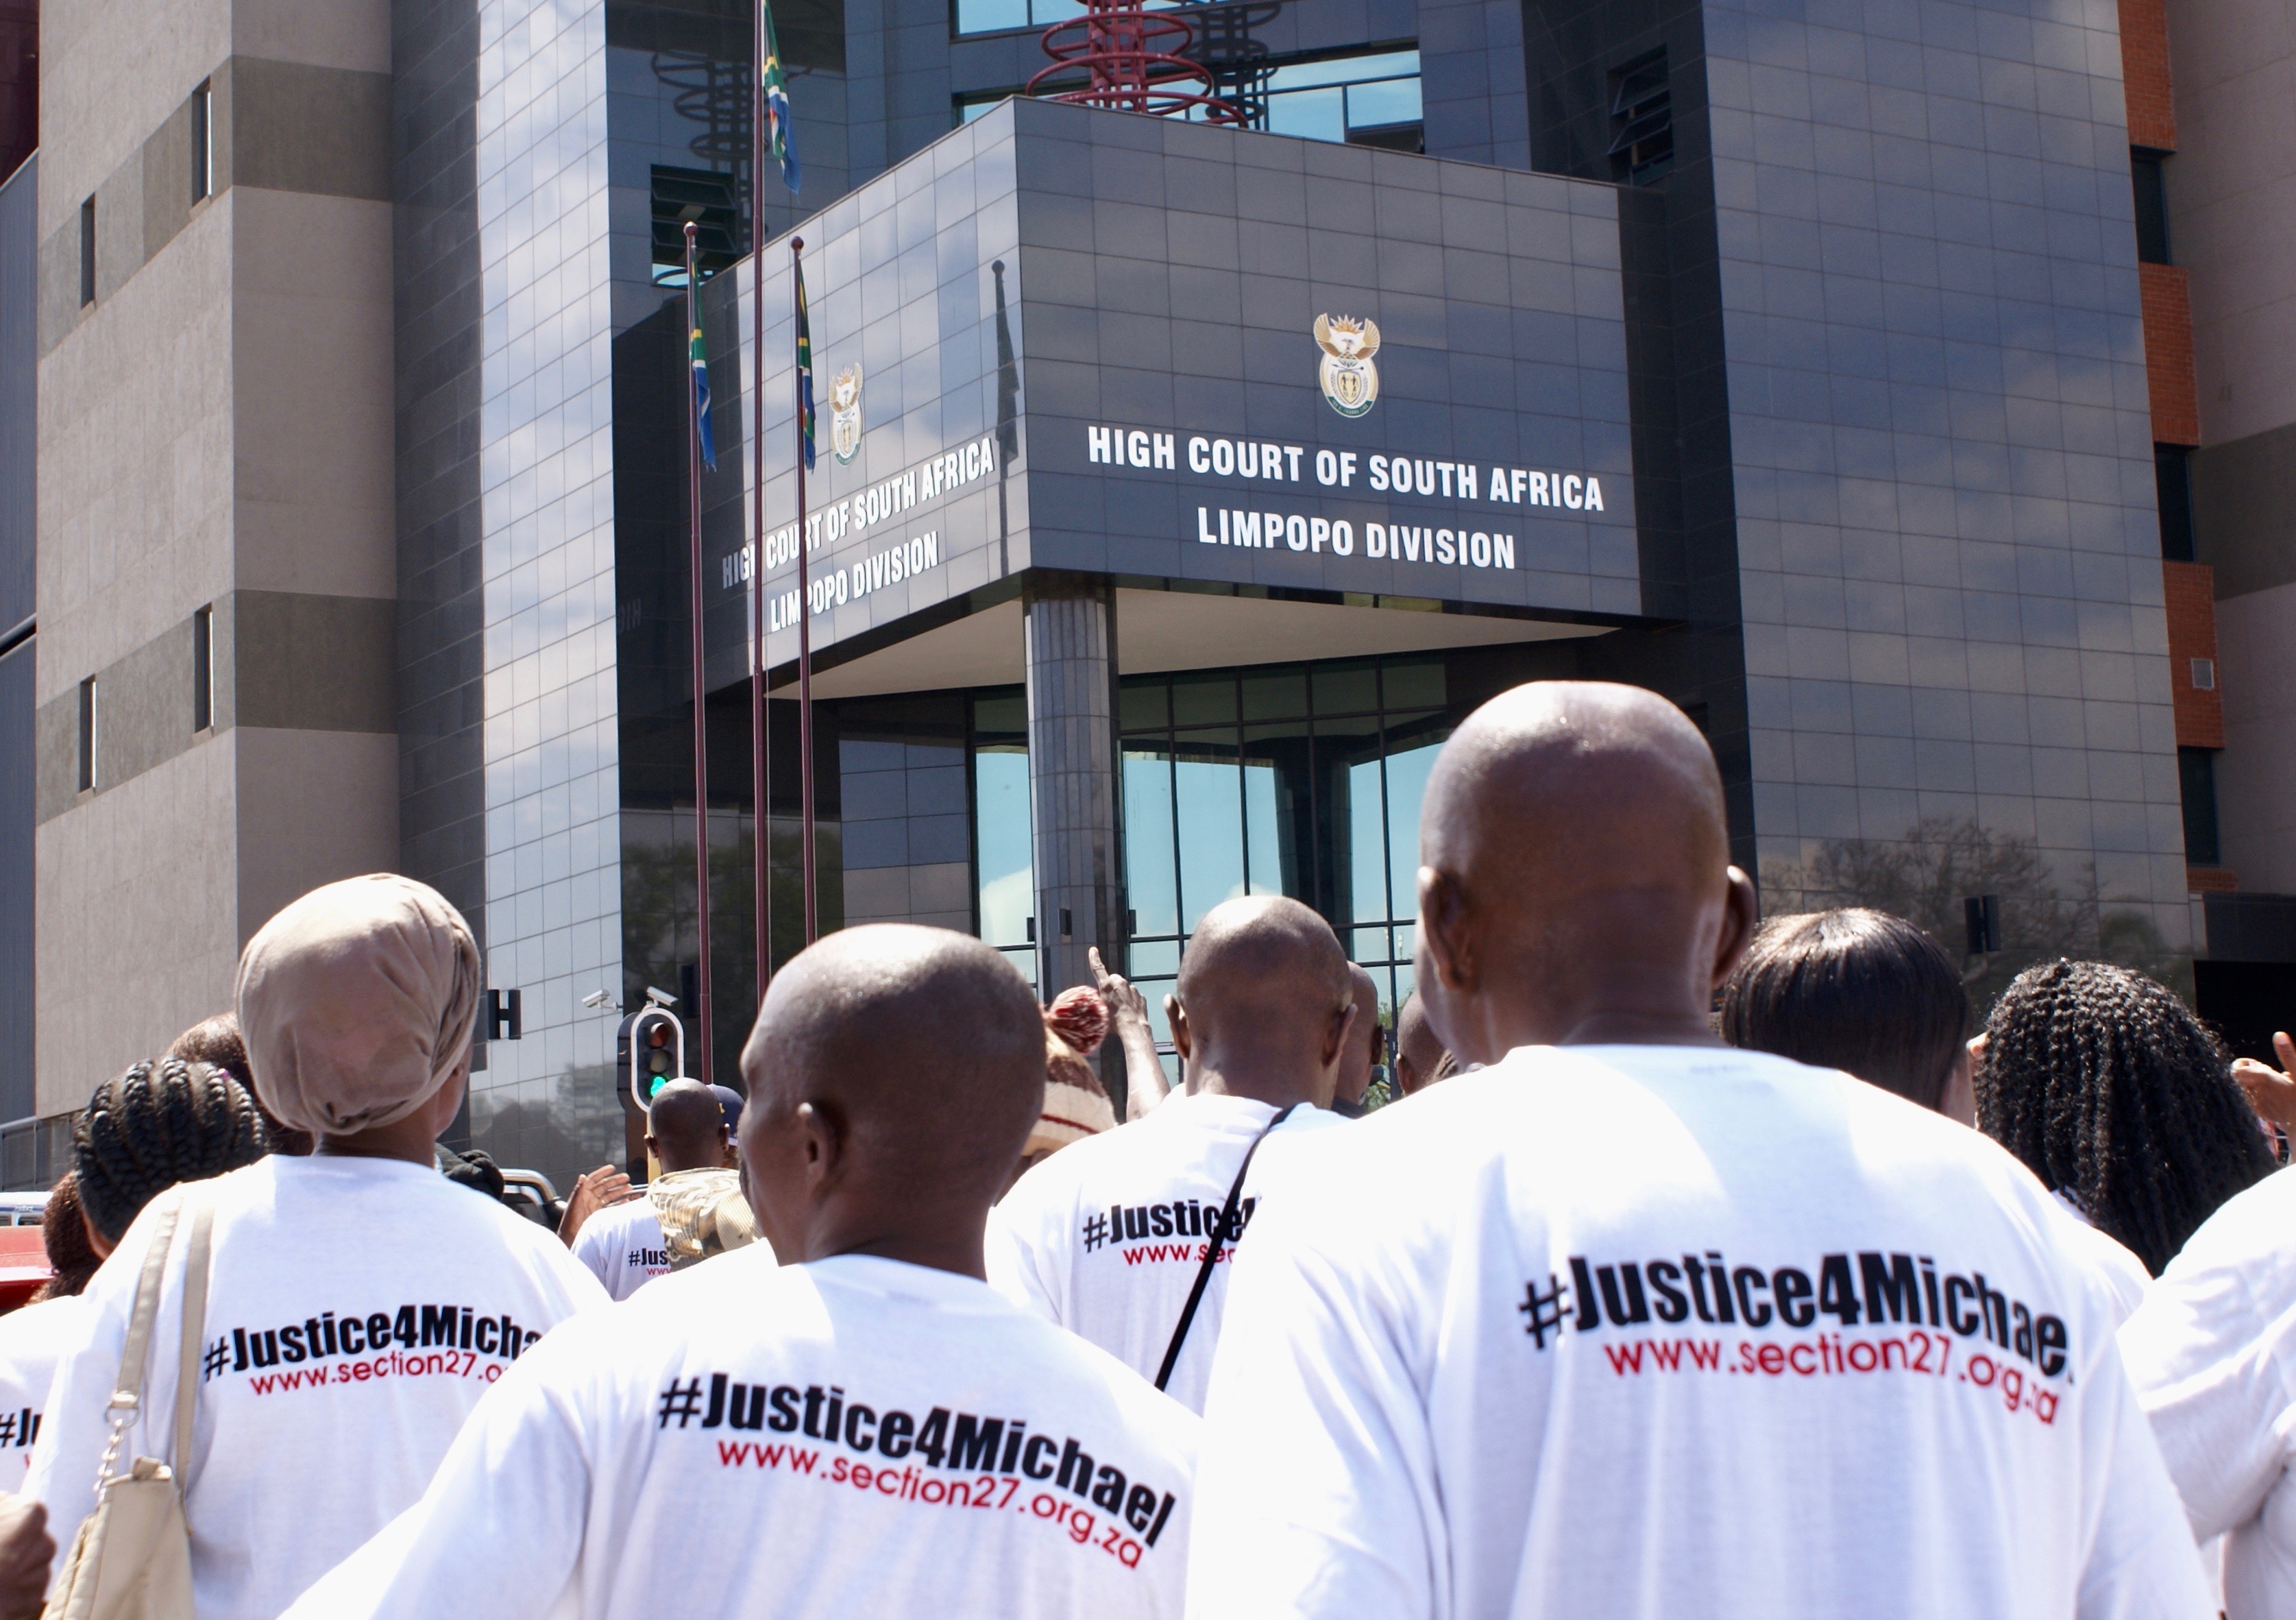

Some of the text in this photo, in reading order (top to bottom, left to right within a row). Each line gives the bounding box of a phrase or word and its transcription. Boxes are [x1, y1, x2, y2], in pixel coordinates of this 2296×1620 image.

[827, 501, 850, 542] OF
[855, 471, 916, 531] SOUTH
[922, 437, 994, 501] AFRICA
[1088, 426, 1604, 511] HIGH COURT OF SOUTH AFRICA
[853, 531, 938, 599] DIVISION
[1197, 507, 1515, 570] LIMPOPO DIVISION
[1519, 1251, 2073, 1384] #Justice4Michae
[658, 1373, 1176, 1548] #Justice4Michael
[716, 1440, 1144, 1570] www.section27.org.za
